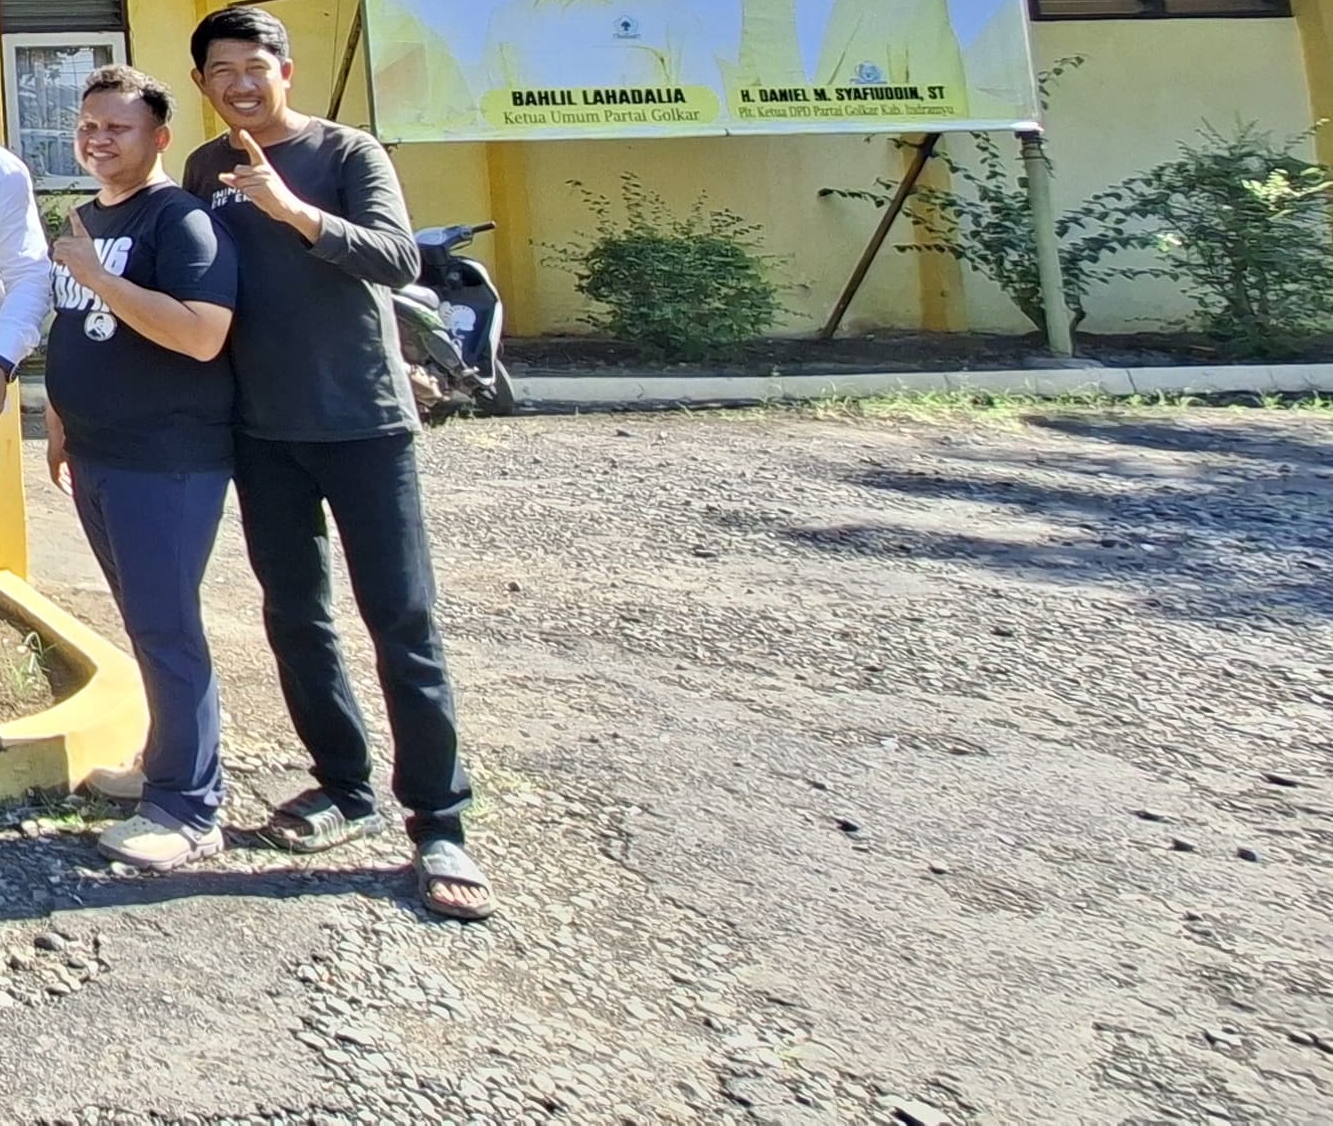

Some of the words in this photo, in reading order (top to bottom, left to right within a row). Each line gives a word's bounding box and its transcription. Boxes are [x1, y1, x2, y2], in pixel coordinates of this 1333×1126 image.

[511, 89, 577, 107] BAHLIL
[583, 87, 687, 106] LAHADALIA
[741, 89, 755, 103] H.
[759, 88, 810, 103] DANIEL
[814, 88, 831, 102] M.
[835, 86, 924, 103] SYAFIUDDIN,
[928, 85, 946, 100] ST
[503, 111, 546, 125] Ketua
[550, 110, 601, 124] Umum
[604, 109, 647, 123] Partai
[651, 107, 701, 122] Golkar
[738, 107, 755, 118] Plt.
[757, 106, 788, 118] Ketua
[789, 106, 811, 117] DPD
[813, 104, 843, 116] Partai
[845, 104, 879, 116] Golkar
[881, 103, 902, 115] Kab.
